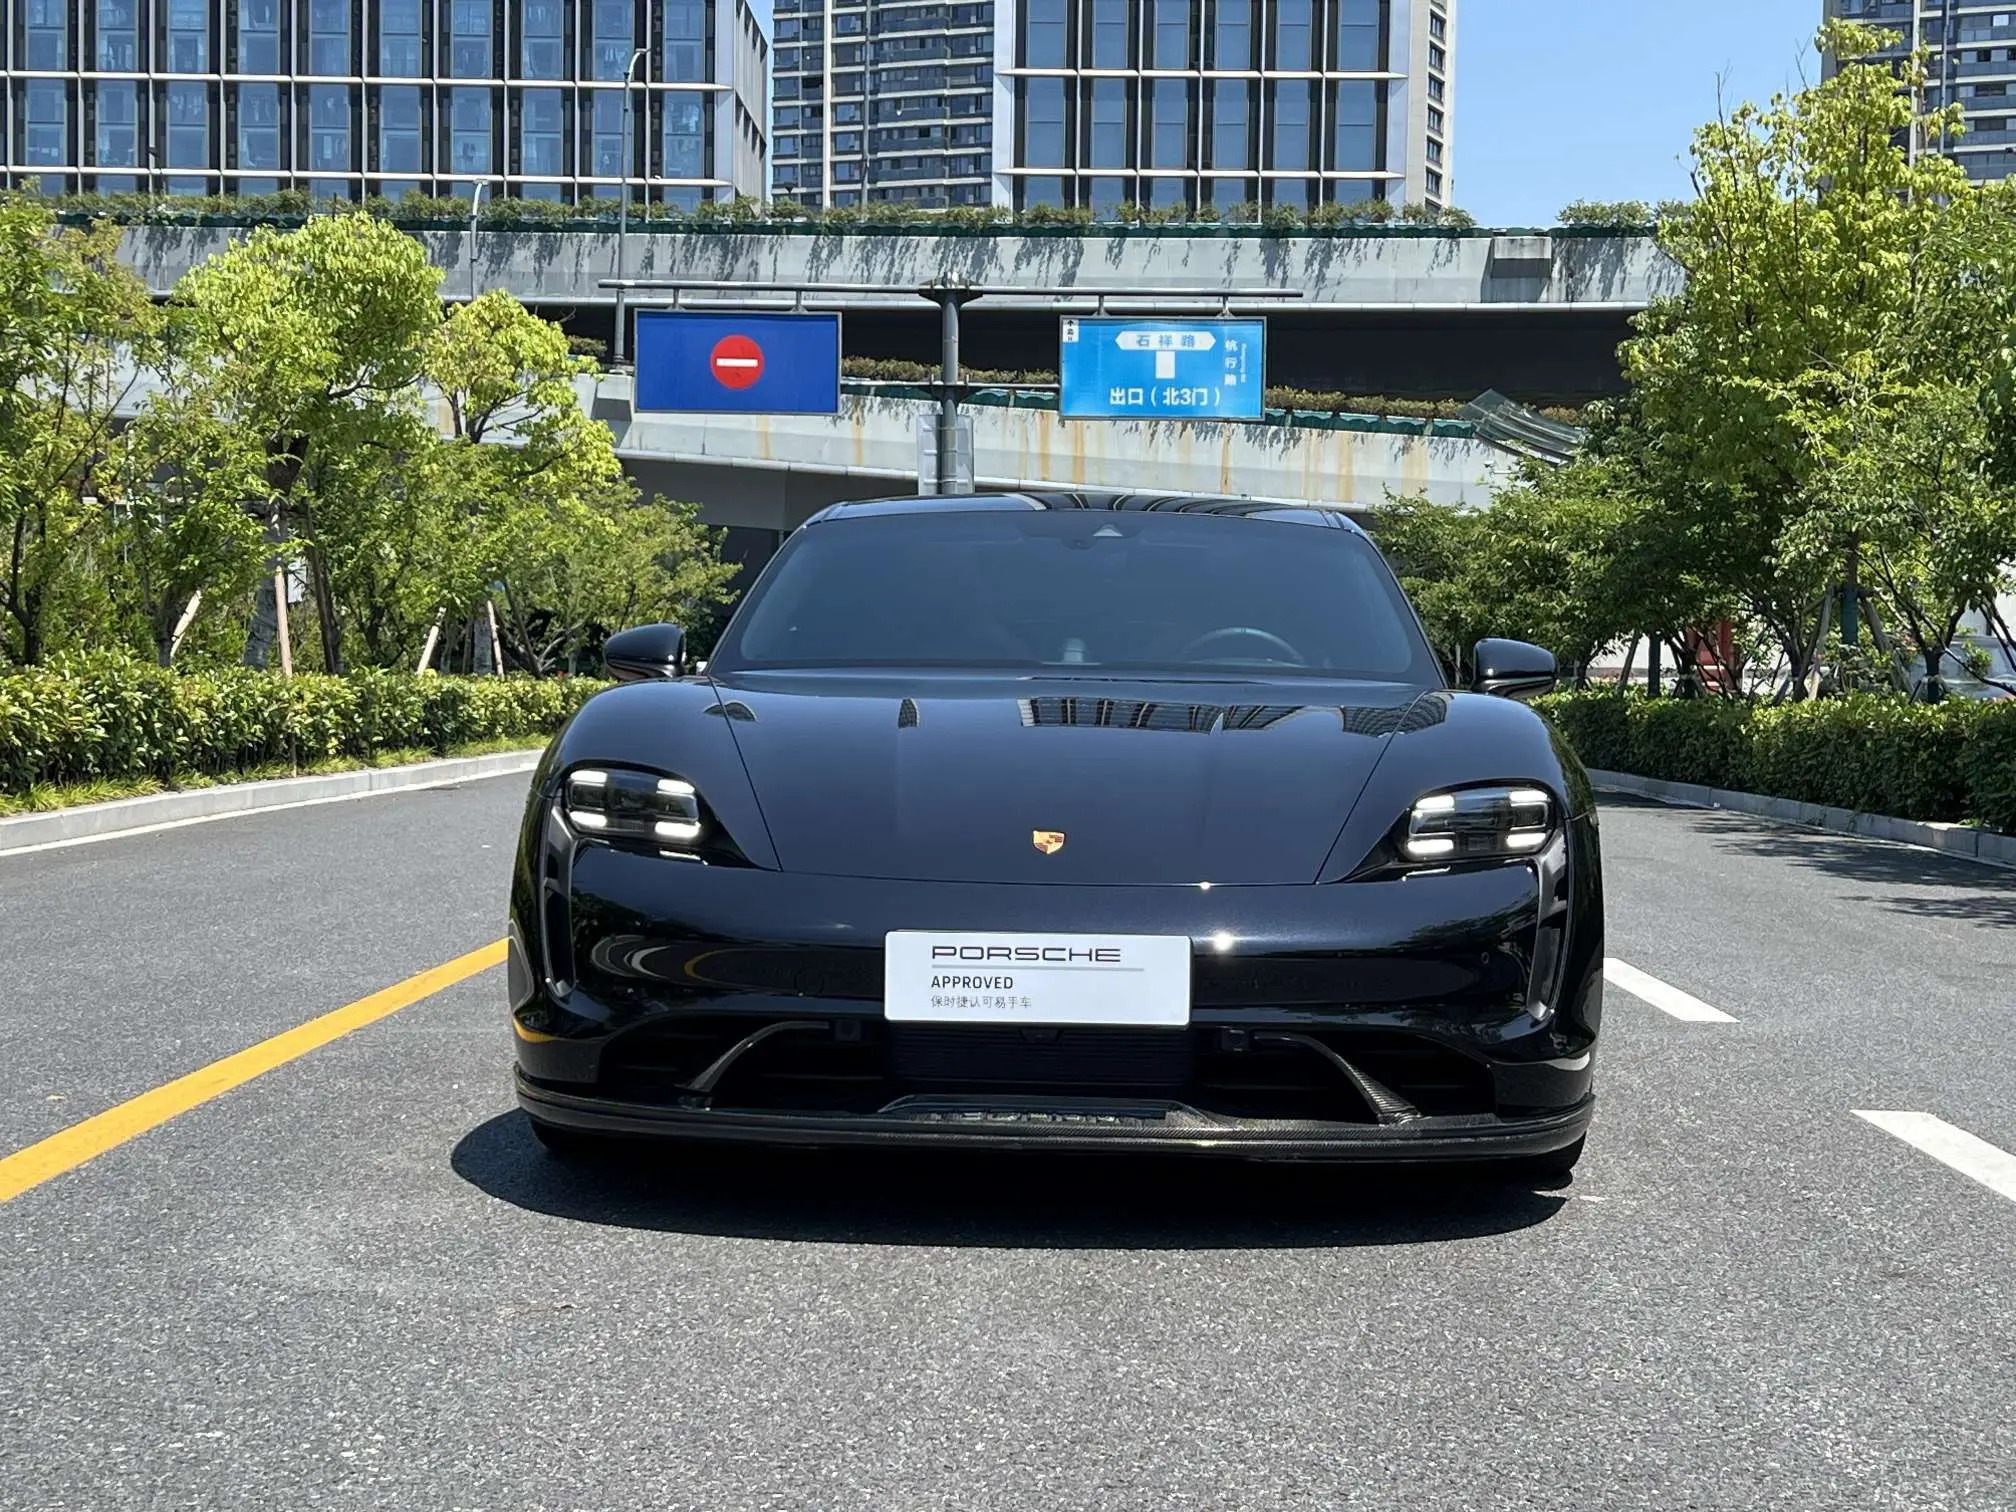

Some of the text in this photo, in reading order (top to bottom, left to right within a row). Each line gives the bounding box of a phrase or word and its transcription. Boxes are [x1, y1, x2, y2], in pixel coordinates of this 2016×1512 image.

[932, 946, 1121, 962] PORSCHE
[931, 975, 1014, 989] APPROVED
[930, 995, 1032, 1009] 保时捷认可易手车
